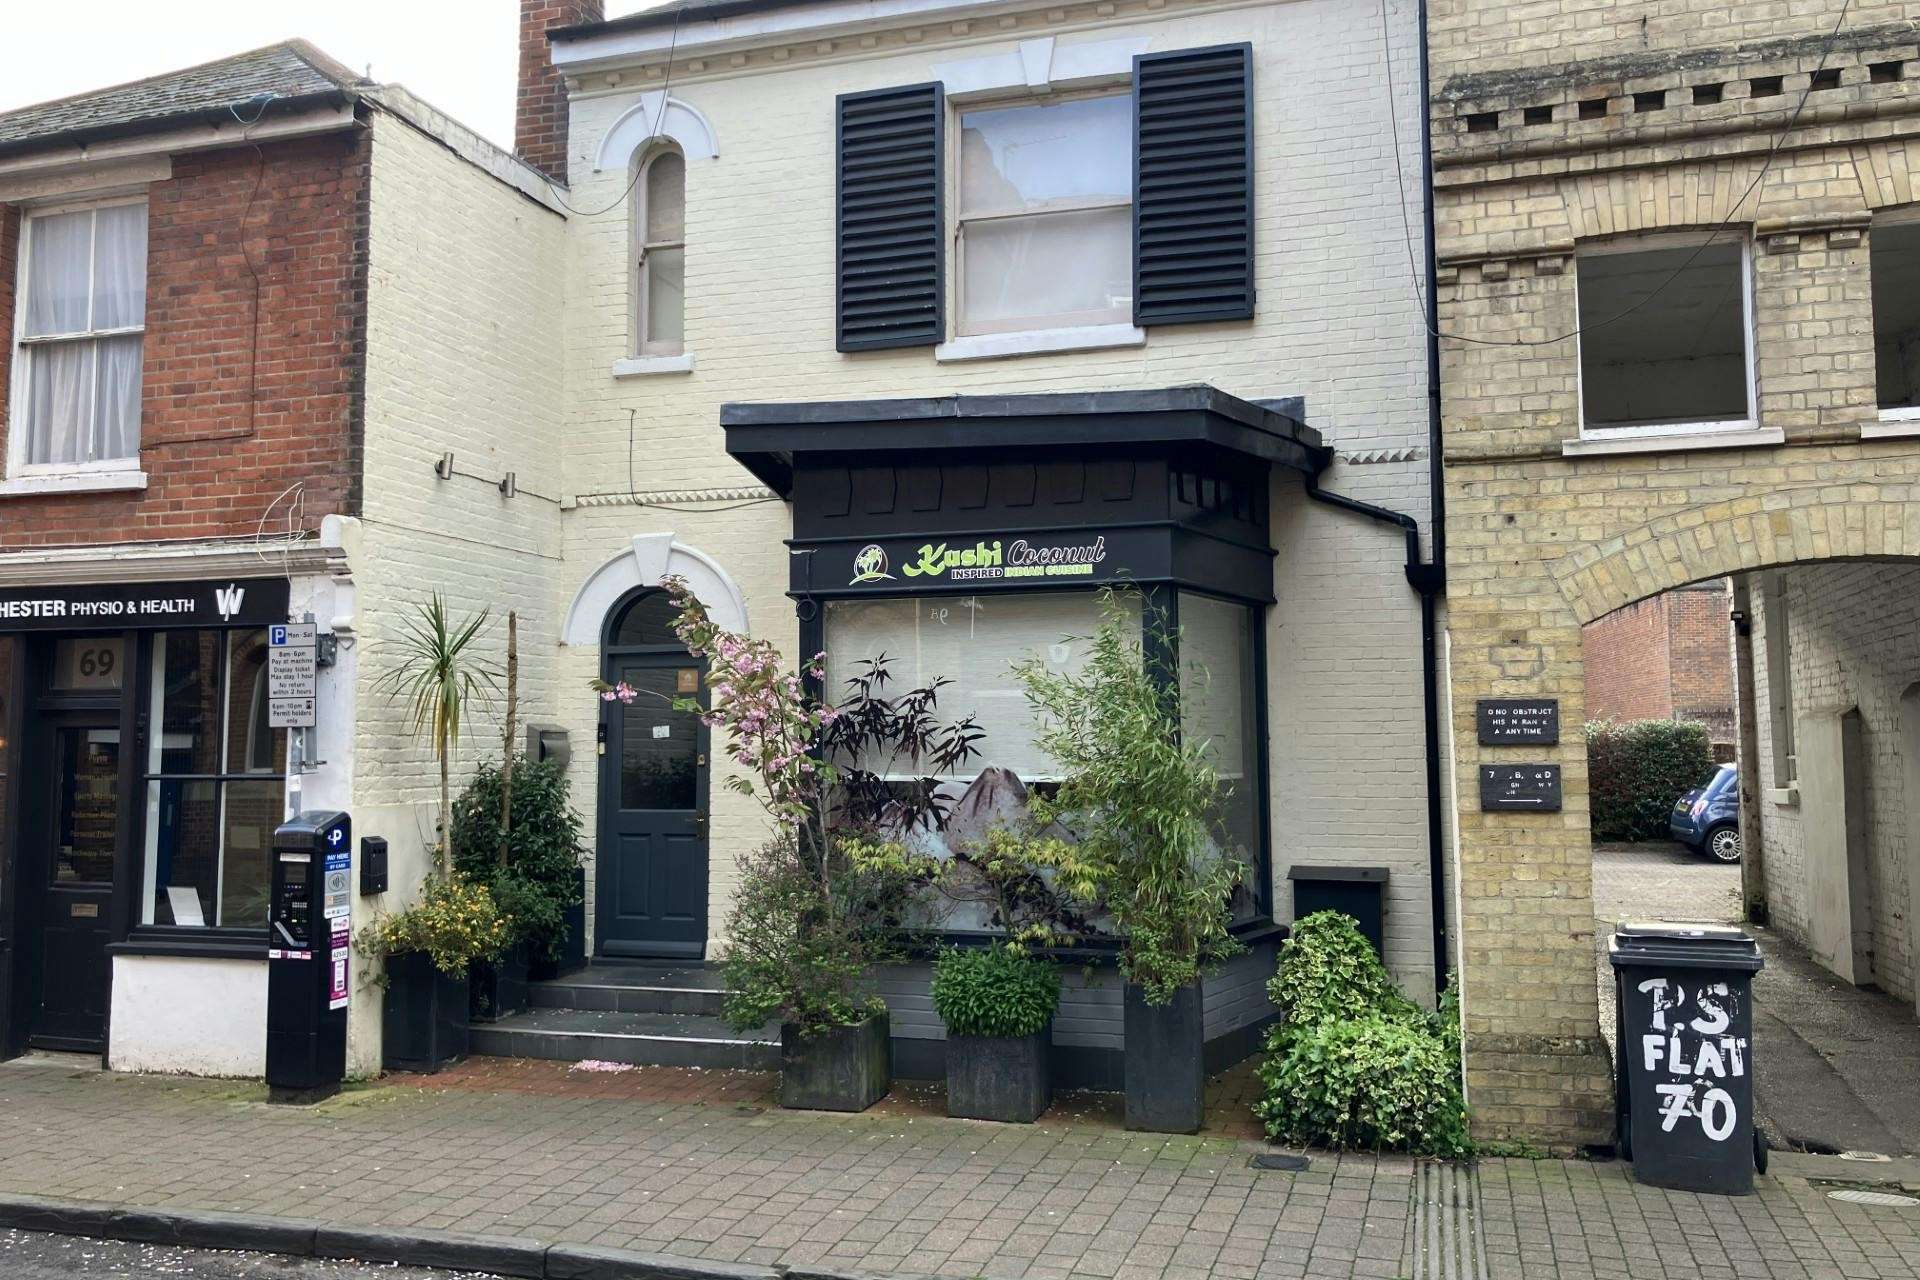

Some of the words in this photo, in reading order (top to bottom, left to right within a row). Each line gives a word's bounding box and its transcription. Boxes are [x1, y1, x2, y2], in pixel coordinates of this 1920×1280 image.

[902, 541, 1002, 577] Kushi
[1007, 536, 1106, 566] Coconut
[951, 567, 1004, 580] INSPIRED
[1004, 565, 1045, 577] INDIAN
[1045, 563, 1093, 575] CUISINE
[71, 601, 124, 616] PHYSIO
[126, 602, 137, 614] &
[140, 598, 195, 614] HEALTH
[275, 628, 285, 644] P
[80, 649, 114, 676] 69
[1544, 771, 1552, 779] D
[1643, 1034, 1748, 1078] FLAT
[1655, 1084, 1737, 1141] 70
